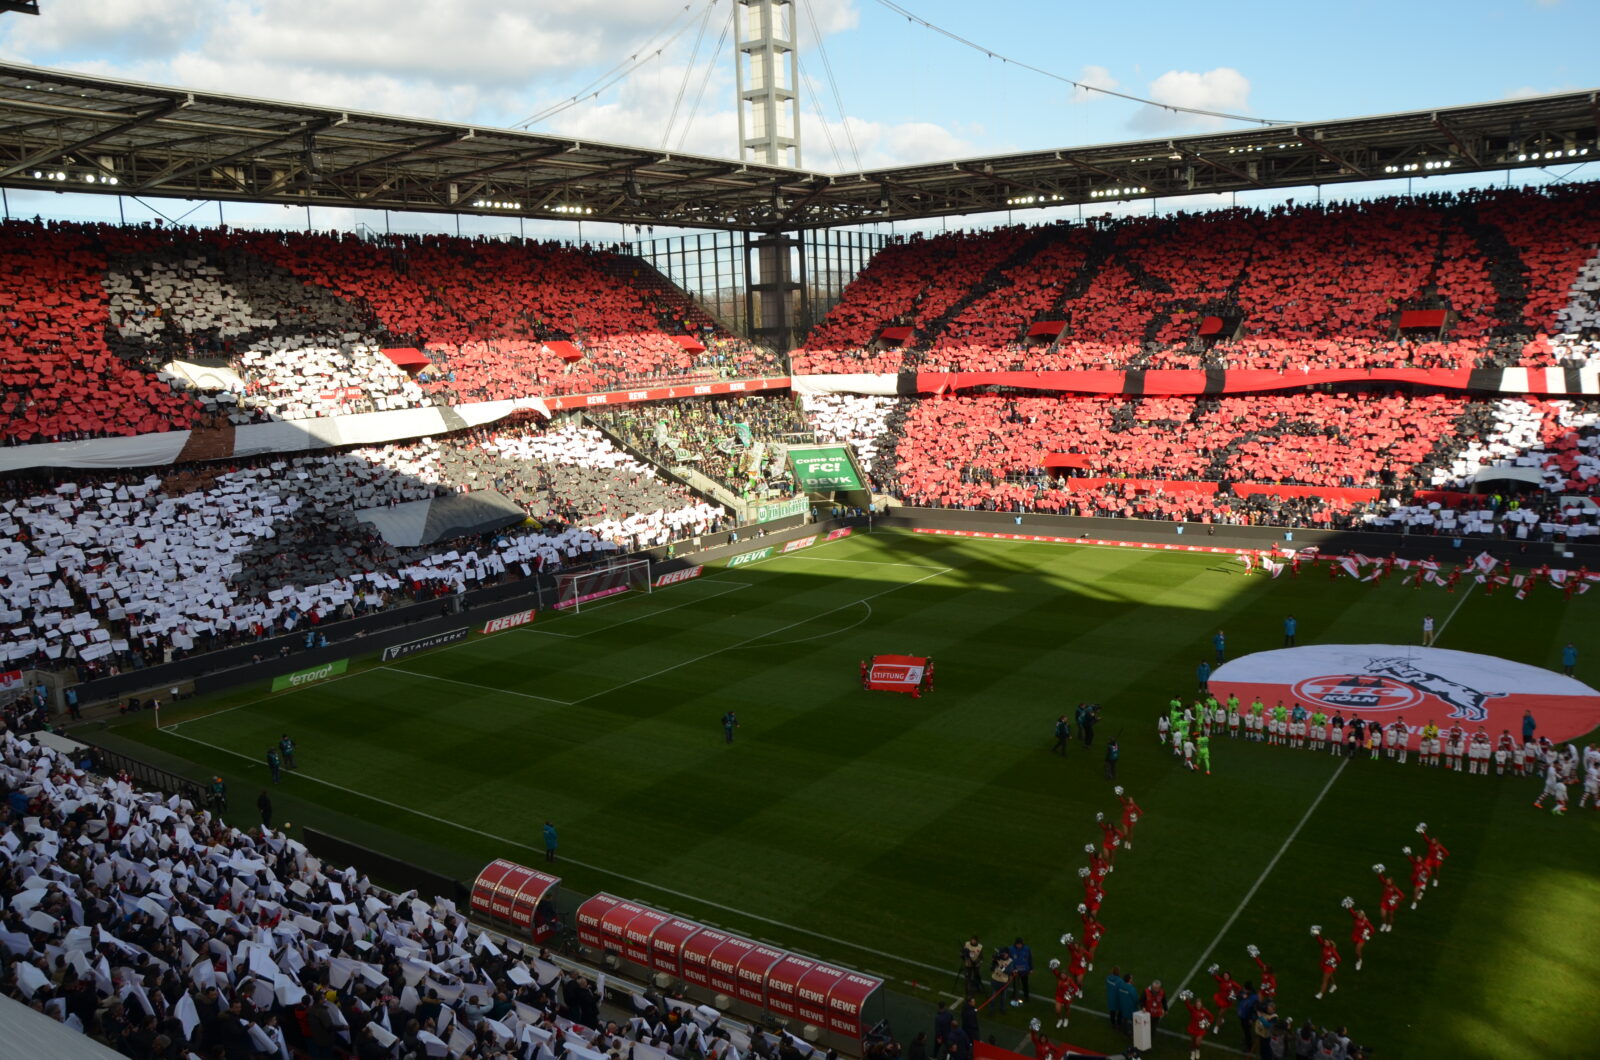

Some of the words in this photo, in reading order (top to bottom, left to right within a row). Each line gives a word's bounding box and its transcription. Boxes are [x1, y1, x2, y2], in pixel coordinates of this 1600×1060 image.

[587, 395, 607, 404] REWE
[628, 391, 648, 400] REWE
[694, 386, 712, 394] REWE
[730, 383, 746, 391] REWE
[809, 463, 840, 473] FC!
[807, 476, 852, 485] DEVK
[734, 550, 769, 565] DEVK
[662, 567, 700, 584] REWE
[490, 610, 532, 632] REWE
[873, 672, 905, 680] STIFTUNG
[1322, 694, 1380, 703] KÖLN
[1350, 687, 1394, 695] FC
[478, 878, 496, 889] REWE
[498, 886, 516, 896] REWE
[518, 892, 536, 904] REWE
[472, 896, 490, 908] REWE
[492, 902, 510, 915] REWE
[512, 910, 530, 923] REWE
[597, 896, 618, 905] REWE
[621, 904, 643, 913] REWE
[644, 912, 668, 921] REWE
[672, 921, 696, 930] REWE
[702, 930, 726, 940] REWE
[728, 938, 754, 950] REWE
[756, 947, 782, 958] REWE
[786, 956, 813, 968] REWE
[816, 965, 844, 977] REWE
[848, 975, 876, 987] REWE
[579, 914, 598, 927] REWE
[602, 921, 622, 935] REWE
[627, 930, 647, 944] REWE
[654, 939, 676, 953] REWE
[684, 950, 706, 964] REWE
[711, 959, 734, 974] REWE
[738, 968, 762, 984] REWE
[769, 978, 794, 994] REWE
[799, 988, 824, 1004] REWE
[830, 998, 857, 1014] REWE
[580, 932, 599, 944] REWE
[604, 940, 623, 952] REWE
[628, 949, 648, 962] REWE
[656, 958, 676, 971] REWE
[685, 968, 706, 982] REWE
[712, 978, 734, 992] REWE
[740, 988, 762, 1002] REWE
[770, 998, 794, 1013] REWE
[800, 1008, 824, 1022] REWE
[832, 1018, 857, 1033] REWE
